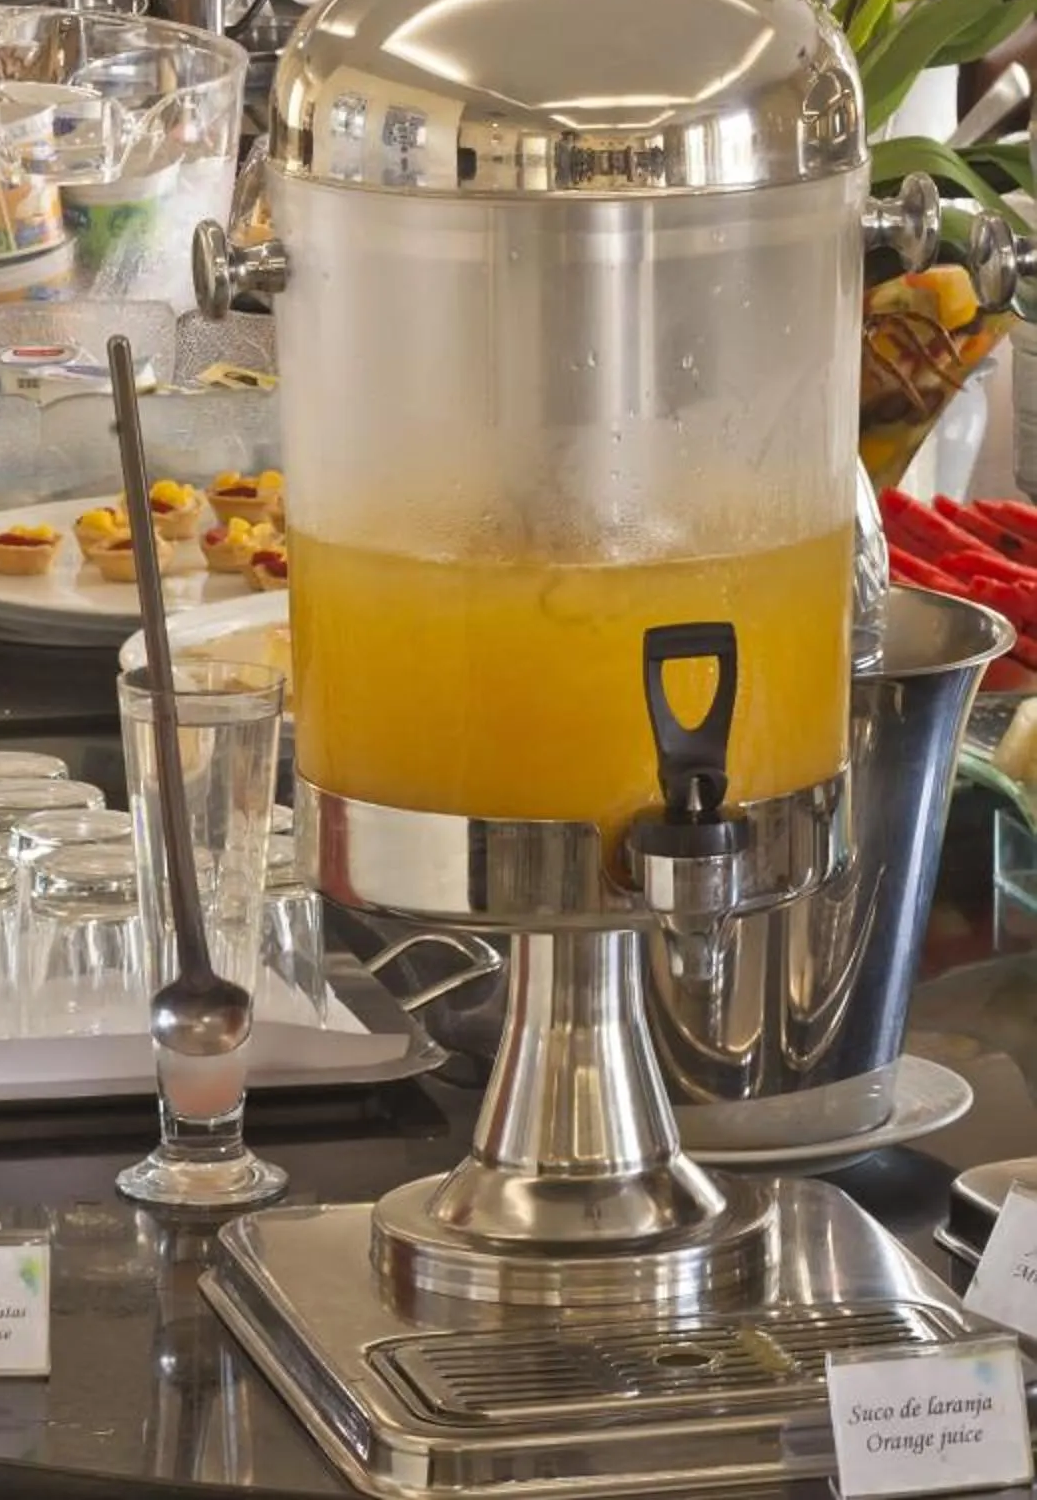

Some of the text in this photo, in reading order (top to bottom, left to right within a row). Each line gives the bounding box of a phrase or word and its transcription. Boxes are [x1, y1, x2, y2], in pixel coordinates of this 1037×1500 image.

[848, 1393, 992, 1426] Suco de laranja
[866, 1425, 983, 1455] Orange juice
